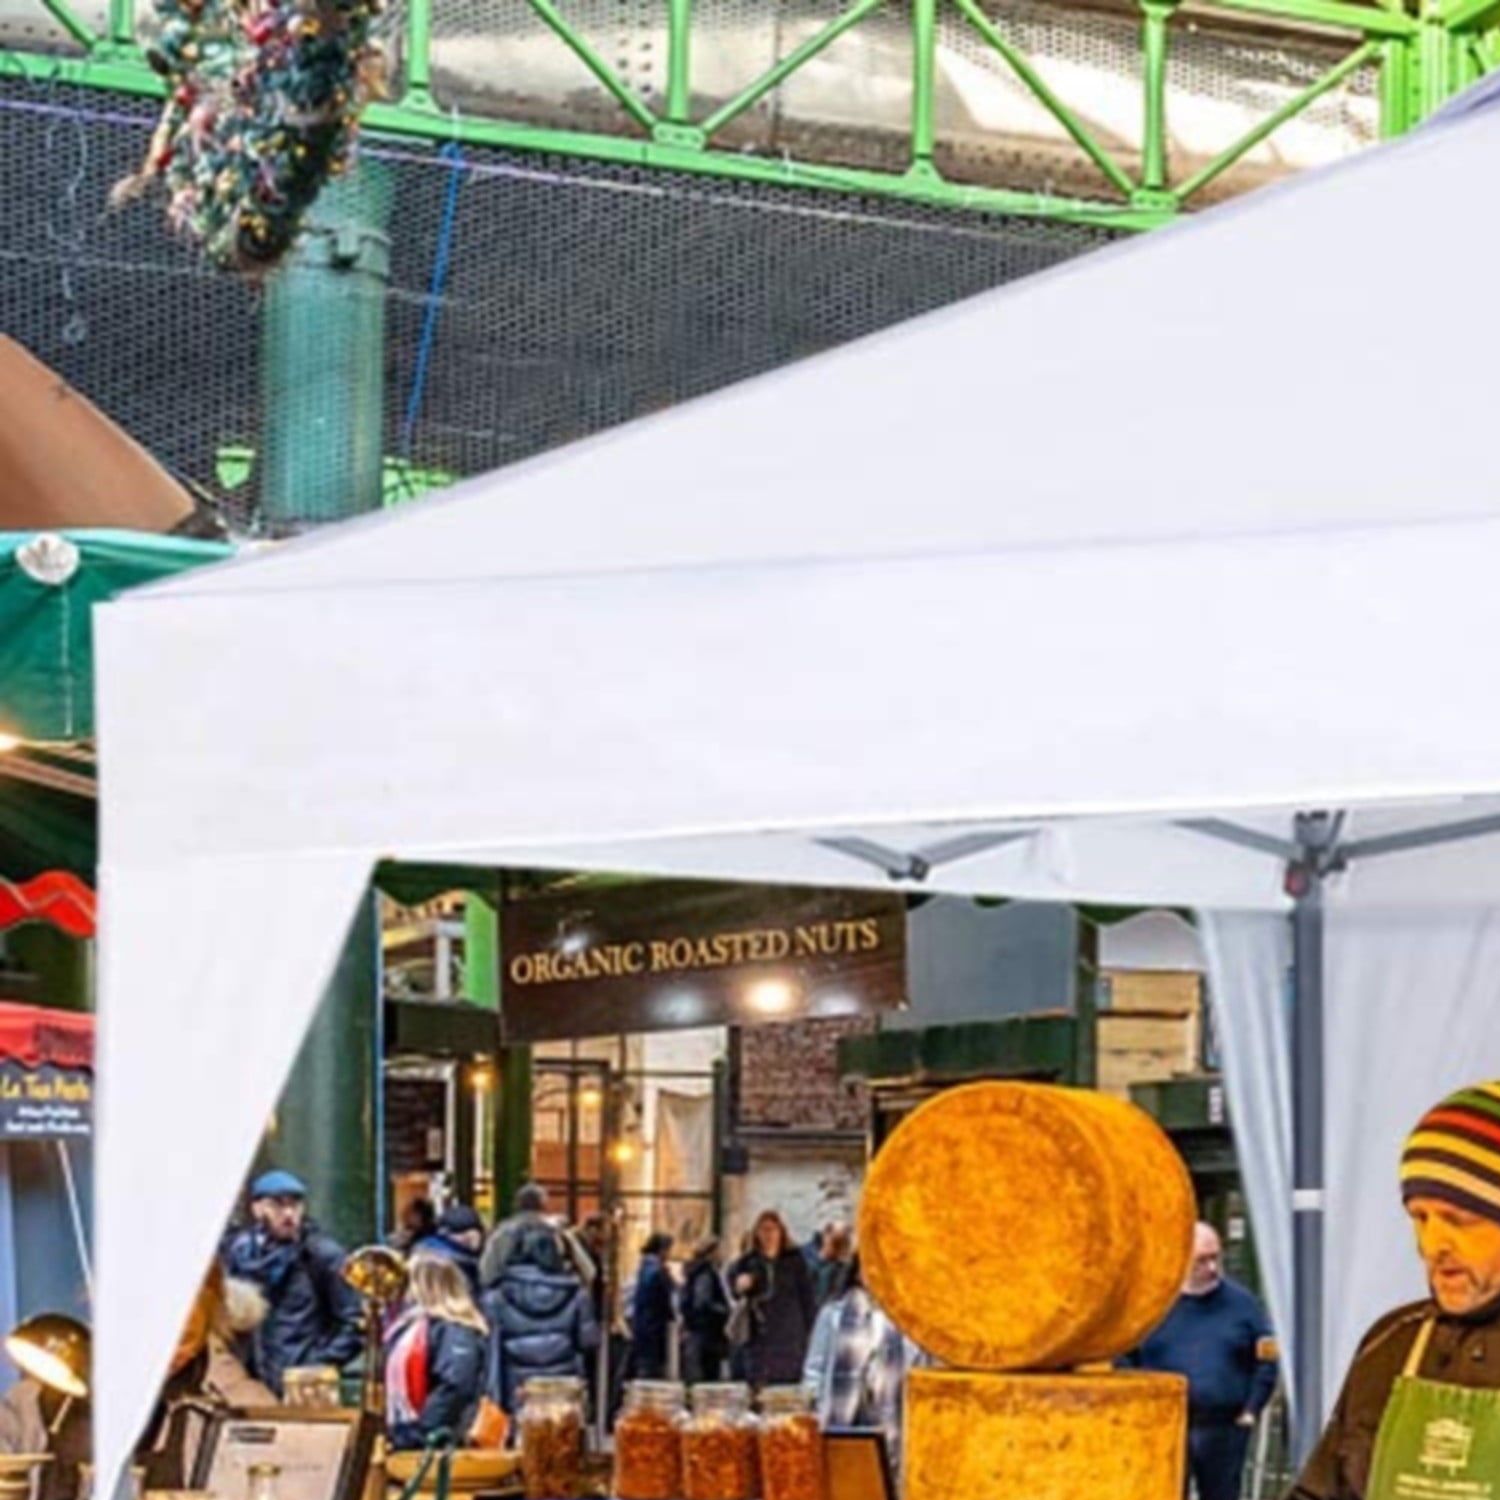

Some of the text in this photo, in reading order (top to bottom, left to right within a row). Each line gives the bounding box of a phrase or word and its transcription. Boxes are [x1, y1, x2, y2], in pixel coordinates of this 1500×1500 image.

[510, 918, 879, 985] ORGANIC ROASTED NUTS
